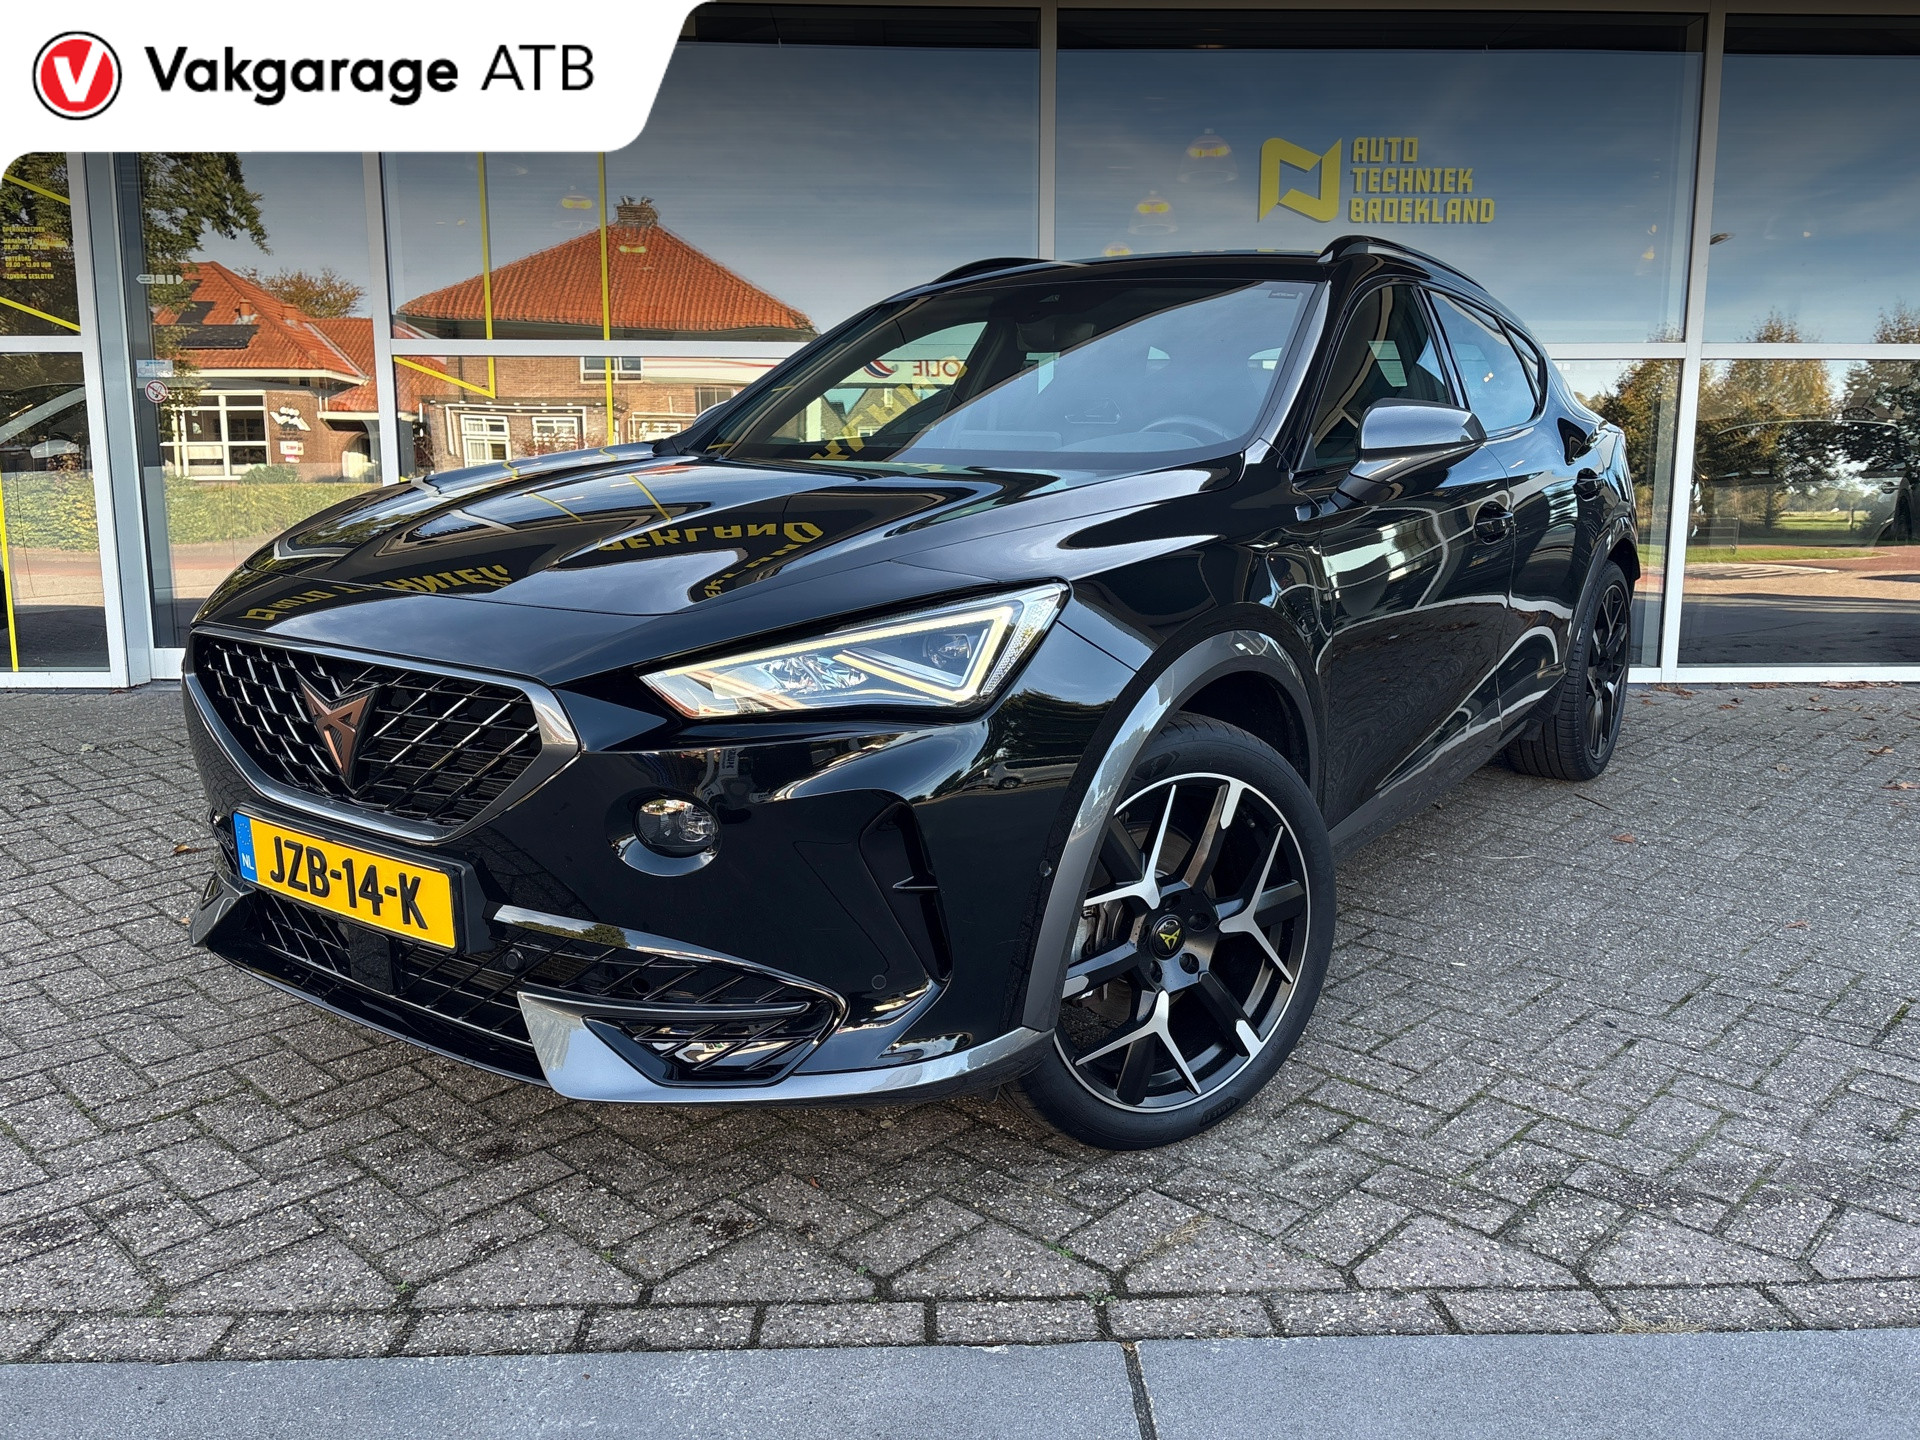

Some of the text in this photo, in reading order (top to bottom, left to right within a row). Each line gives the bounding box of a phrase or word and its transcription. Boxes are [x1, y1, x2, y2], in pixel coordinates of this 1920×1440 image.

[1352, 137, 1419, 163] AUTO
[1352, 168, 1473, 193] TECHNIEK
[1349, 198, 1495, 223] BROEKLAND
[241, 852, 255, 871] NL
[270, 836, 428, 930] JZB-14-K
